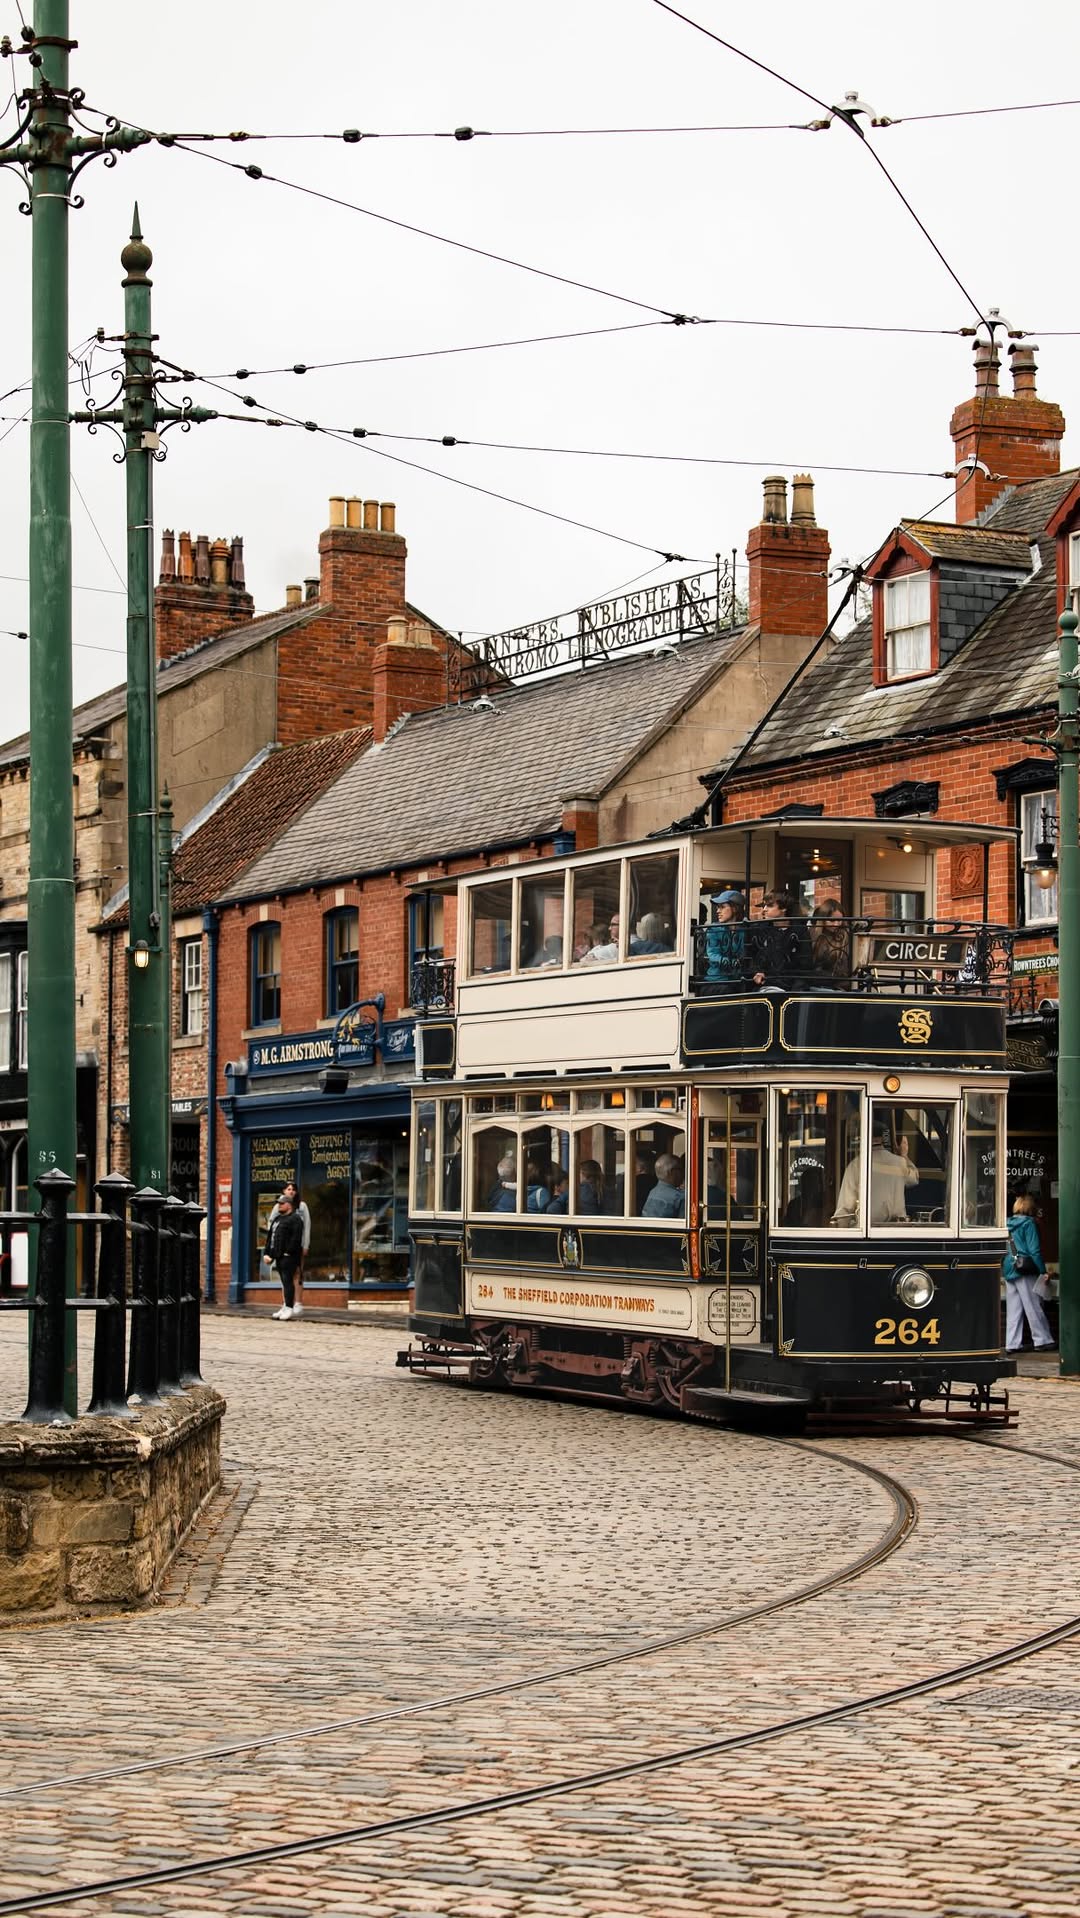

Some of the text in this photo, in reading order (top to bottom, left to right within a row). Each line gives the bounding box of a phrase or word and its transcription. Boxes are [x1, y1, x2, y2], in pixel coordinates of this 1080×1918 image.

[885, 942, 948, 961] CIRCLE
[279, 1040, 334, 1063] ARMSTRONG
[981, 1149, 1045, 1164] RONTREE'S
[503, 1287, 516, 1300] THE
[518, 1288, 558, 1304] SHEFFIELD
[560, 1292, 612, 1310] CORPORATION
[613, 1296, 655, 1313] TRAMWAYS
[874, 1317, 941, 1345] 264
